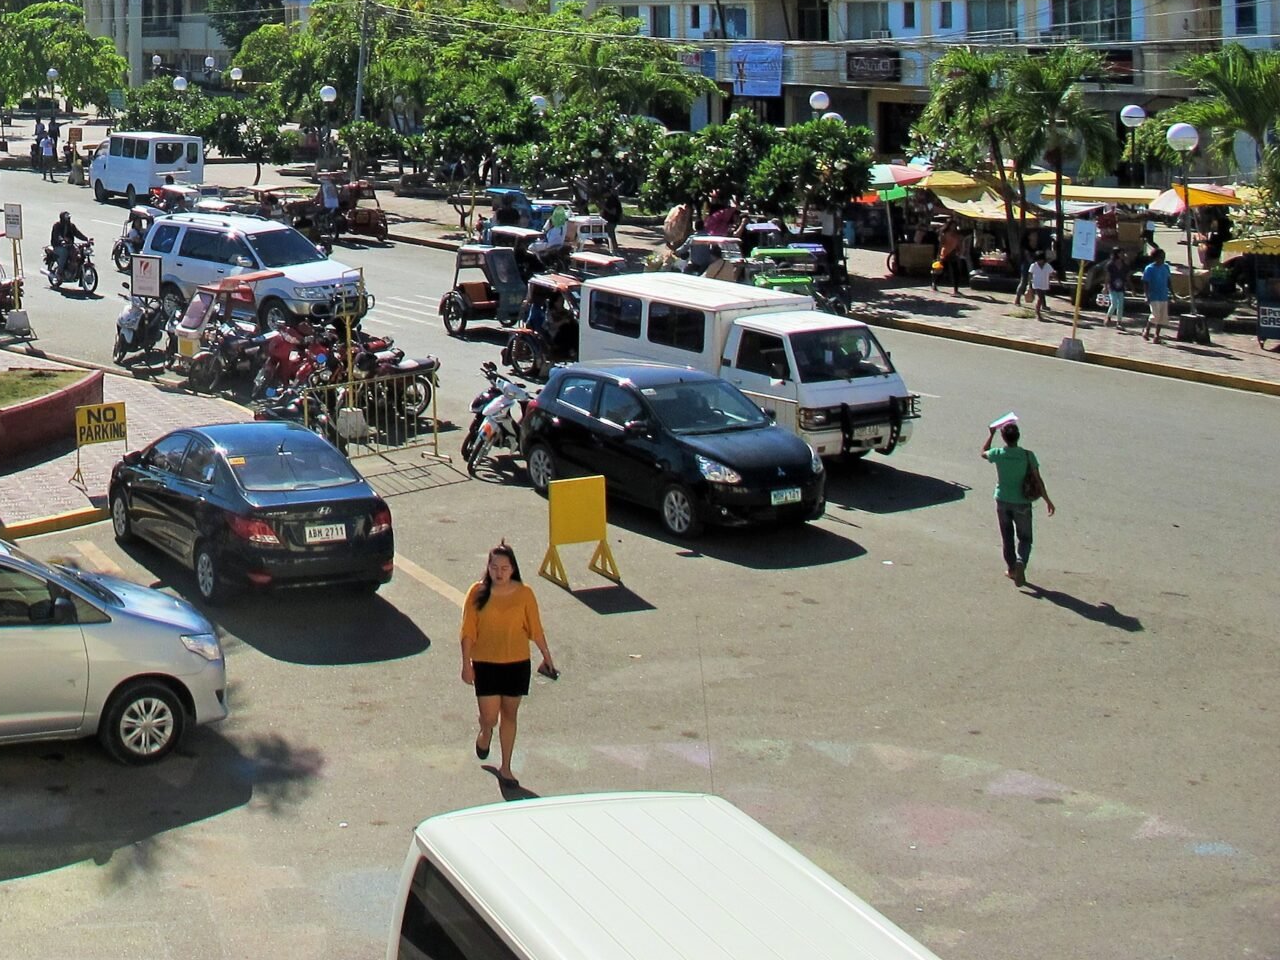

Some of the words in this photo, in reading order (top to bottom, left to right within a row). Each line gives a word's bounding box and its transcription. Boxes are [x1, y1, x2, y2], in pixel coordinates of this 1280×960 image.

[86, 406, 117, 424] NO
[79, 423, 126, 442] PARKING
[325, 526, 344, 537] 2711
